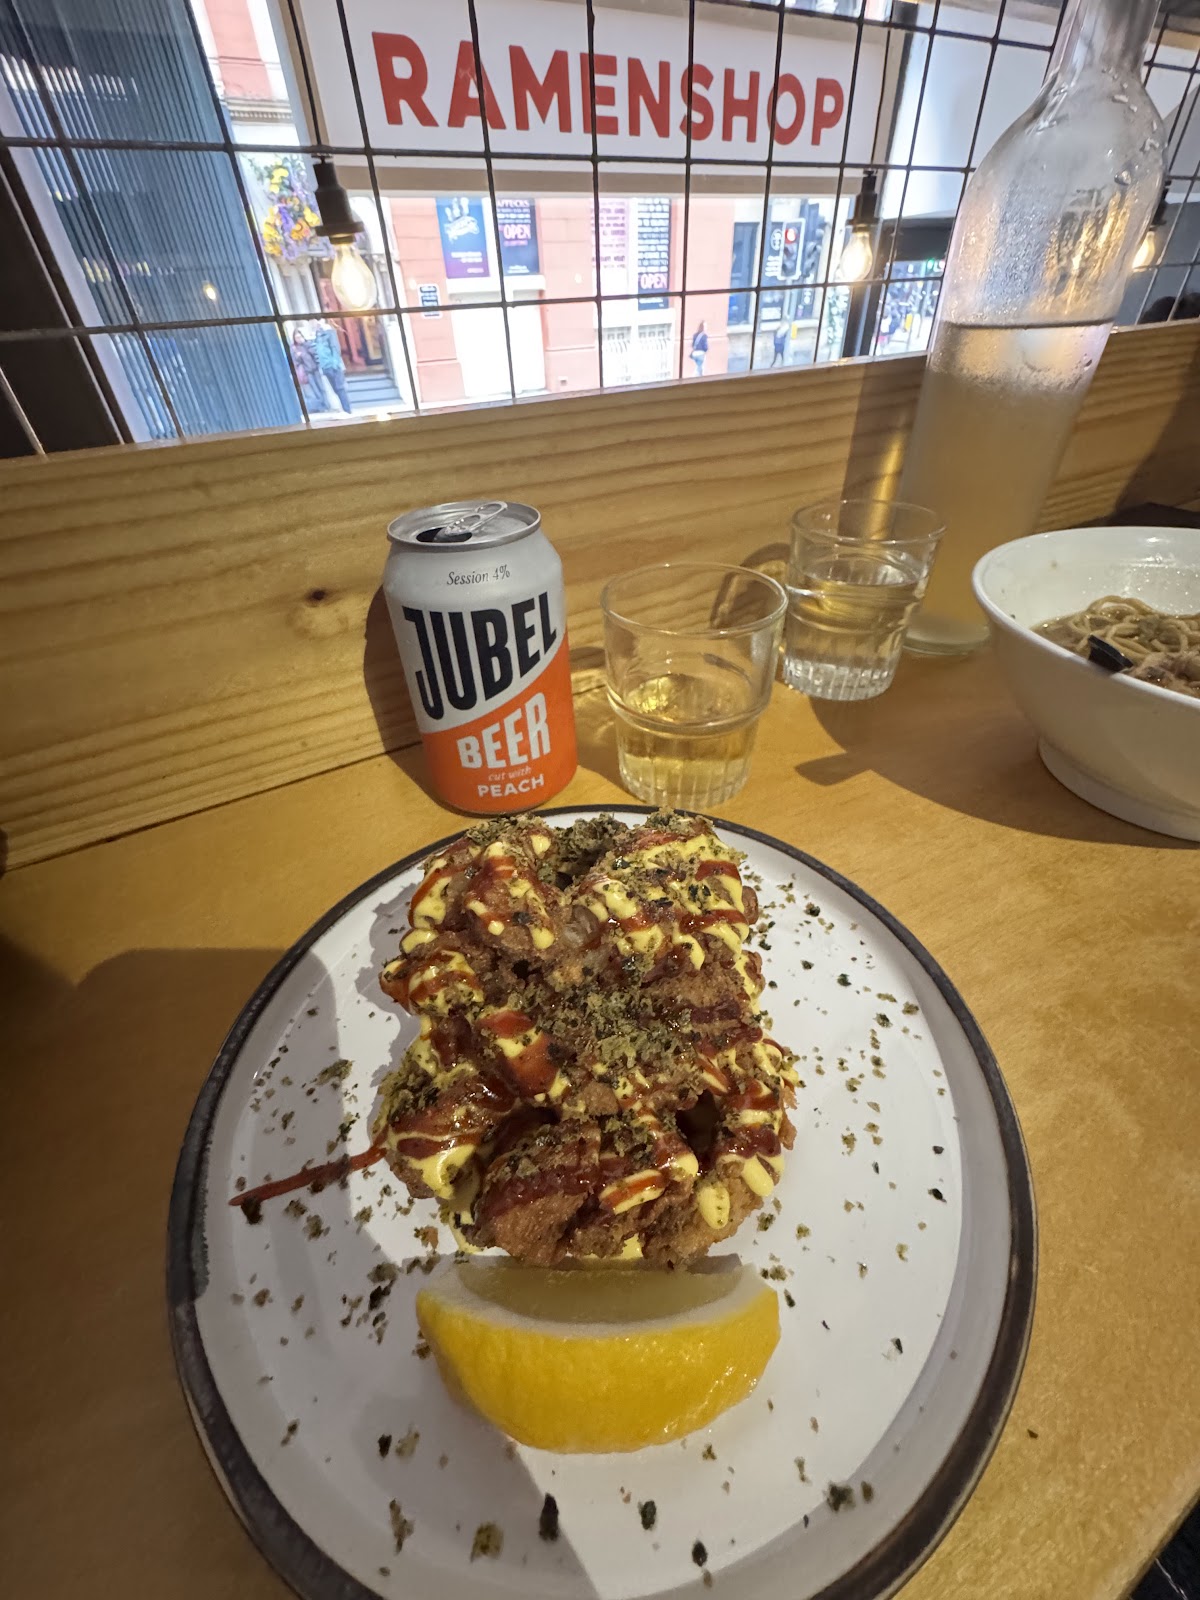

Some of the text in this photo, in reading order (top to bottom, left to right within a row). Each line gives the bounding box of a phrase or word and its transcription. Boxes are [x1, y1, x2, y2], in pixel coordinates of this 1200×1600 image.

[371, 31, 845, 147] RAMENSHOP
[446, 564, 511, 586] Session 4%
[401, 591, 557, 720] JUBEL
[456, 692, 552, 770] BEER
[477, 773, 545, 797] PEACH
[488, 765, 532, 781] cut with
